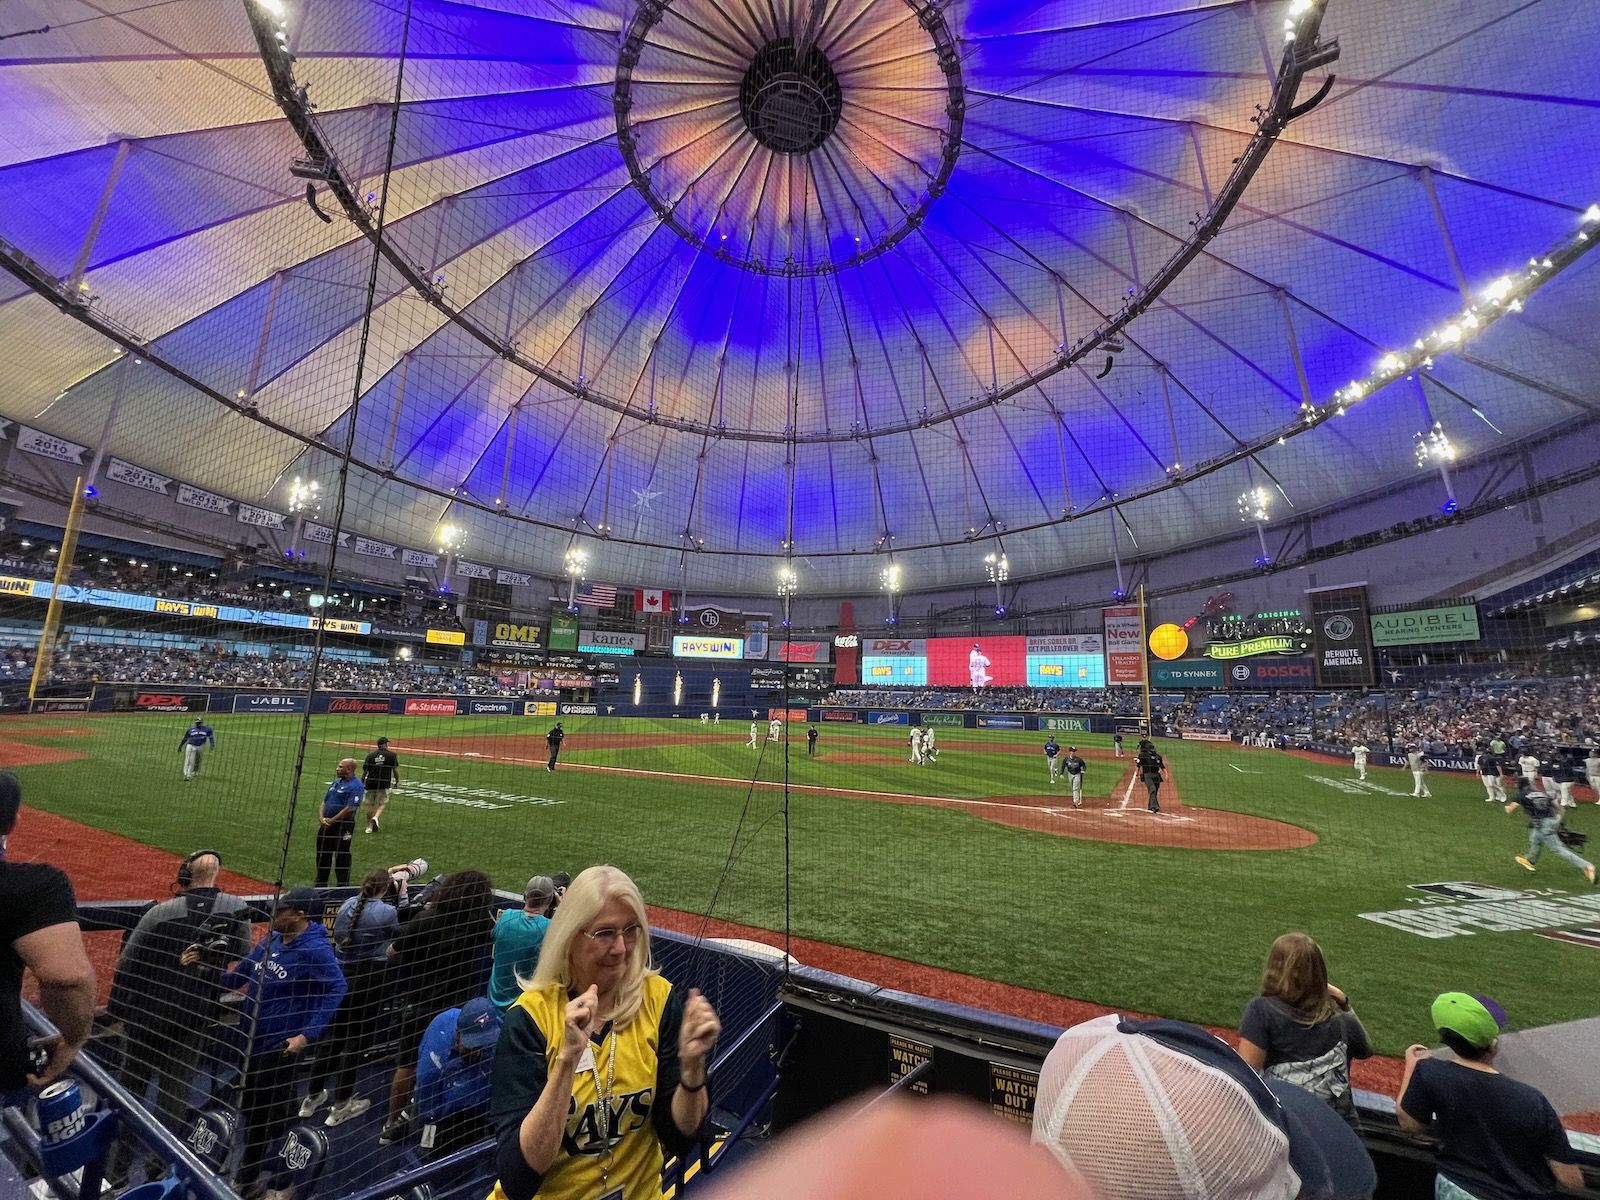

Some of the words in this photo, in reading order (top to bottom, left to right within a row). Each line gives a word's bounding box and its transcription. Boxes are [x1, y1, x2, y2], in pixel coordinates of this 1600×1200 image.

[34, 438, 68, 454] 2010
[24, 443, 74, 462] CHAMPIONS
[113, 472, 135, 484] WILD
[137, 480, 161, 492] CARD
[124, 469, 153, 484] 2011
[182, 497, 201, 508] WILD
[202, 502, 224, 513] CARD
[191, 494, 218, 506] 2013
[250, 511, 273, 522] 2019
[260, 519, 279, 528] CARD
[364, 543, 387, 554] 2020
[410, 554, 428, 563] 2021
[156, 600, 190, 614] RAYS
[1258, 610, 1301, 619] ORIGINAL
[1374, 612, 1475, 630] AUDIBEL
[496, 623, 540, 642] GMF
[1108, 629, 1140, 639] New
[1384, 628, 1420, 636] HEARING
[1424, 624, 1463, 632] CENTERS
[592, 632, 634, 646] kanes
[872, 640, 912, 650] DEX
[682, 642, 709, 652] RAYS
[710, 642, 736, 654] WIN!
[1211, 646, 1240, 657] PURE
[1240, 638, 1294, 654] PREMIUM
[1325, 648, 1358, 659] REROUTE
[1324, 656, 1363, 667] AMERICAS
[1257, 665, 1312, 678] BOSCH
[136, 694, 186, 706] DEX
[250, 697, 295, 705] JABIL
[329, 698, 364, 714] Bally
[474, 703, 509, 712] Spectrum
[1057, 719, 1084, 731] RIPA
[995, 1078, 1038, 1098] WATCH
[1004, 1093, 1028, 1110] OUT
